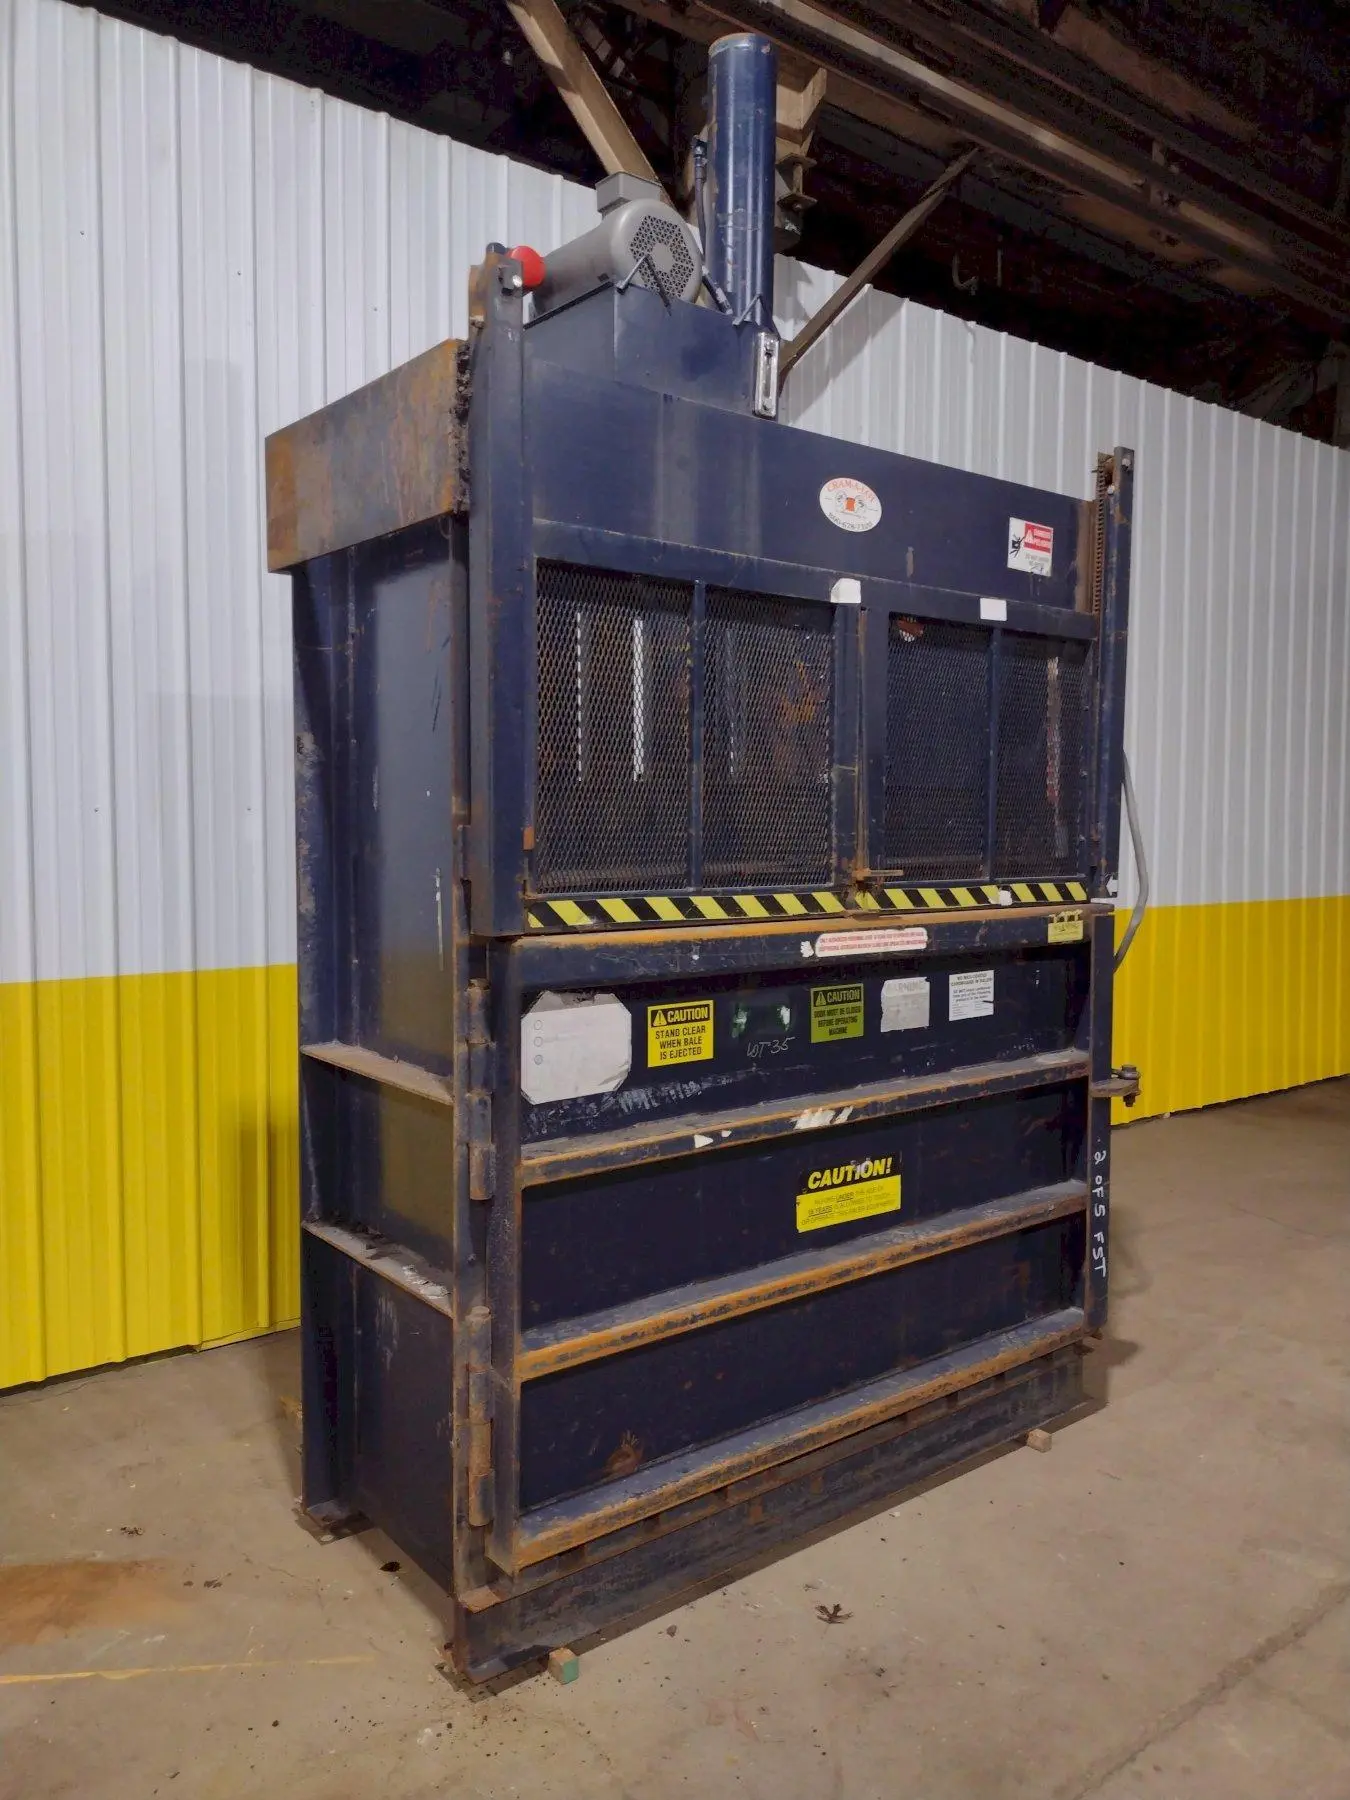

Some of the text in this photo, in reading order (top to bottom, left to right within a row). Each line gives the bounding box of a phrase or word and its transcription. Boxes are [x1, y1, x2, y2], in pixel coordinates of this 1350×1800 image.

[827, 989, 860, 1003] CAUTION
[667, 1006, 708, 1023] CAUTION
[655, 1025, 706, 1039] STAND CLEAR
[660, 1036, 703, 1049] WHEN BALE
[660, 1046, 702, 1060] IS EJECTED
[808, 1158, 892, 1189] CAUTION!
[836, 1192, 855, 1202] UNDER
